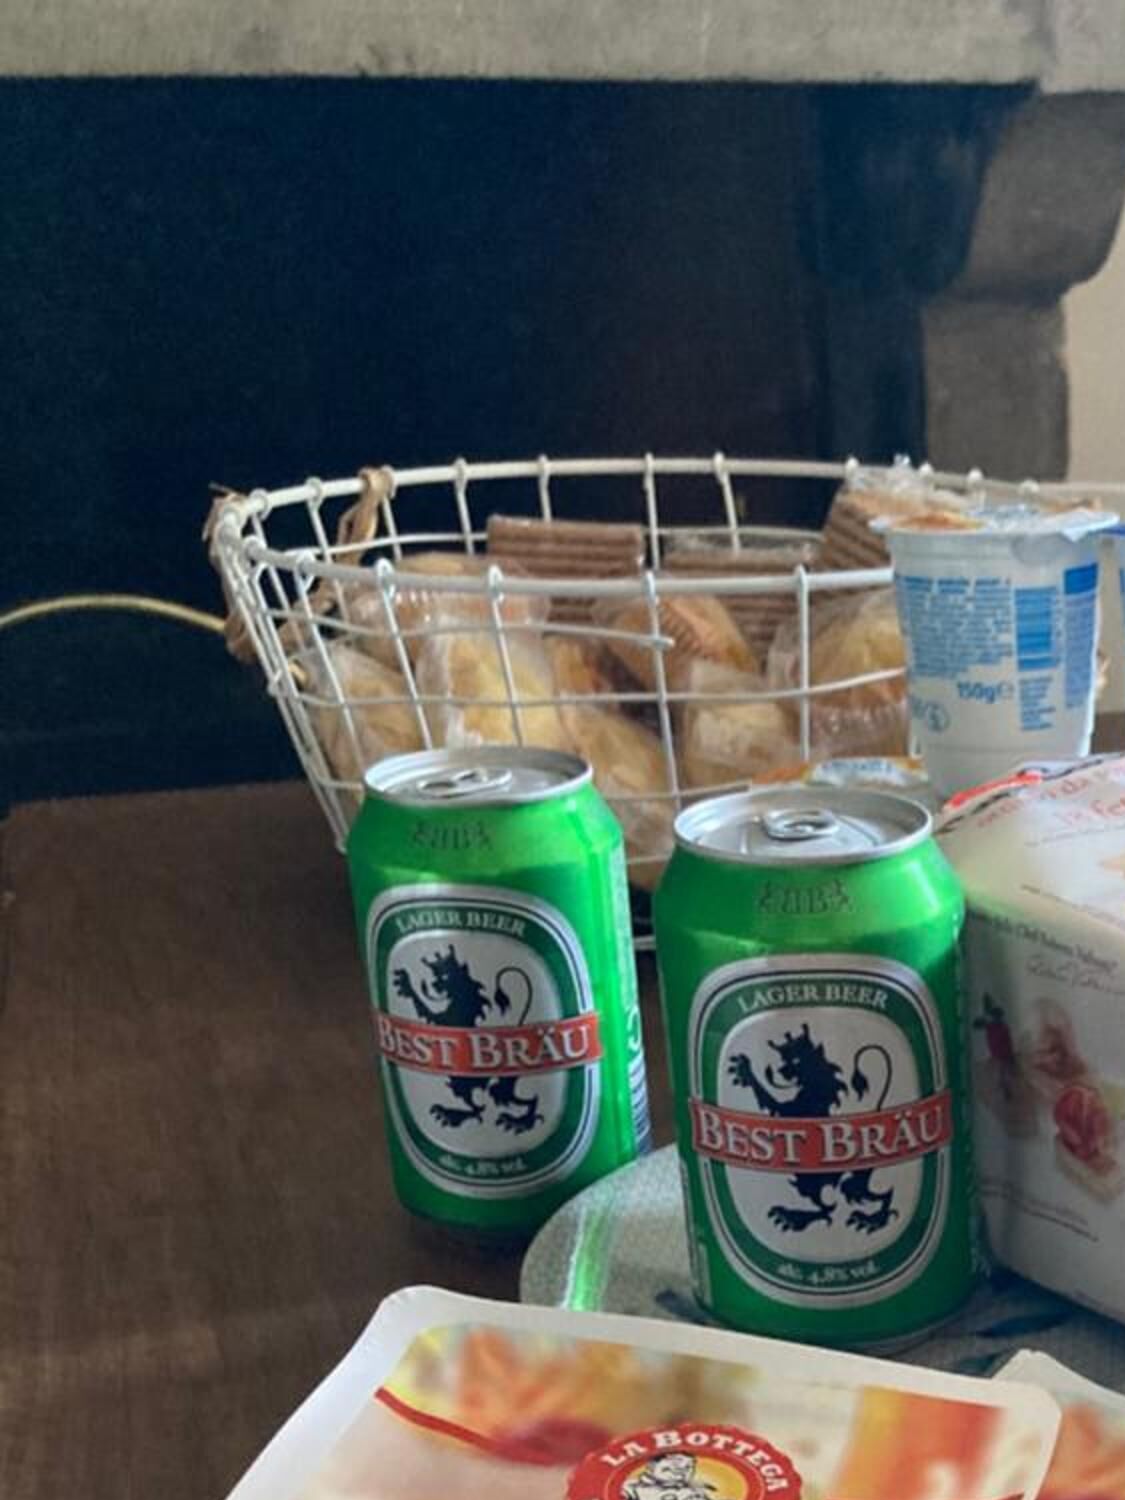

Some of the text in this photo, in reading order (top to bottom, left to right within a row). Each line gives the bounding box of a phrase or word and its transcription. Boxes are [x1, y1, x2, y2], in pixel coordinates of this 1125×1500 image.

[394, 908, 526, 938] LAGER BEER
[737, 984, 889, 1010] LAGER BEER
[379, 1021, 592, 1069] BEST BRÄU
[700, 1105, 946, 1165] BEST BRÄU
[602, 1427, 787, 1492] LA BOTTEGA
